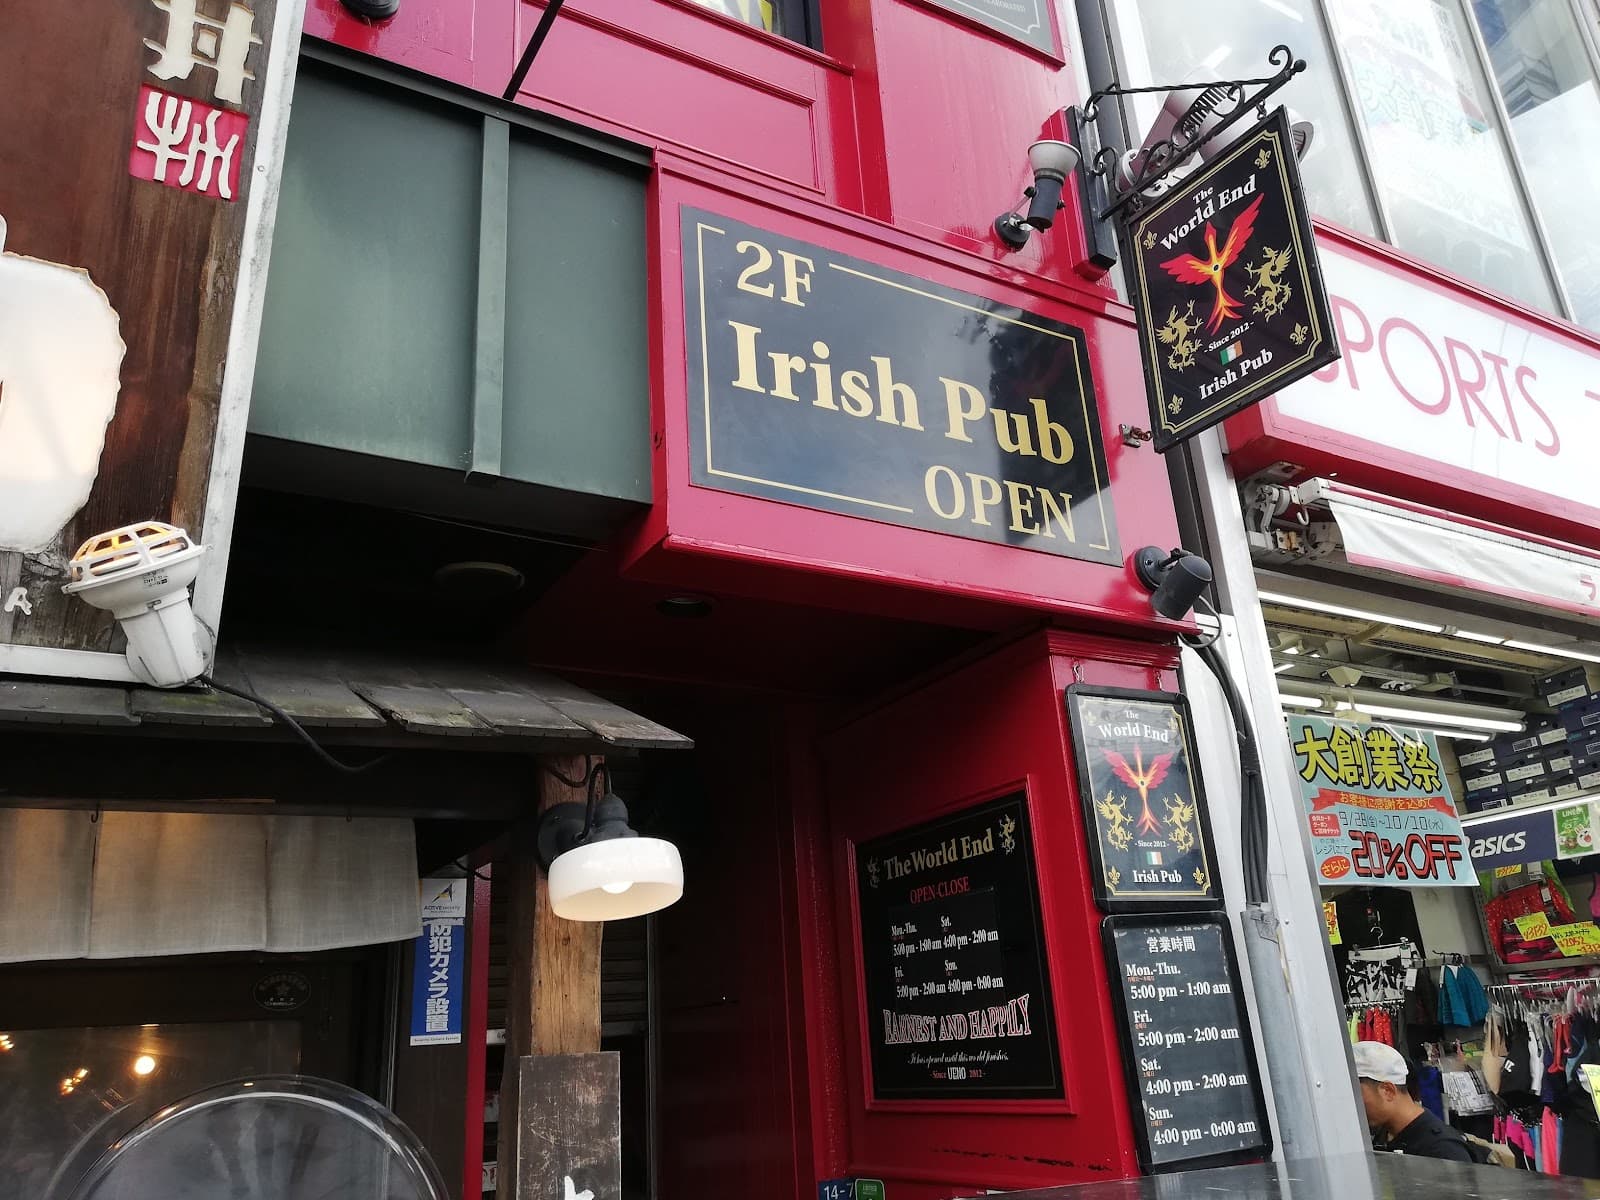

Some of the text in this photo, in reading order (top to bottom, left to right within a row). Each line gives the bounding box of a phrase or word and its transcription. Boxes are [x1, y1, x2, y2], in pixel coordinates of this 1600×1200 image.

[1193, 185, 1213, 204] The
[1160, 175, 1256, 250] World End
[736, 240, 814, 307] 2F
[1230, 324, 1250, 341] 2012
[1199, 350, 1272, 400] Irish Pub
[1312, 294, 1560, 457] PORTS
[728, 319, 1074, 464] Irish Pub
[925, 466, 1075, 543] OPEN
[1124, 710, 1139, 720] The
[1099, 722, 1169, 743] World End
[1295, 725, 1442, 794] 大創業祭
[884, 828, 994, 880] The World End
[1153, 840, 1167, 848] 2012
[1348, 830, 1462, 880] 20%OFF
[1133, 870, 1182, 883] Irish Pub
[1321, 858, 1349, 877] さらに
[910, 876, 969, 904] OPEN-CLOSE
[958, 936, 968, 949] pm
[972, 929, 986, 943] 2:00
[987, 930, 998, 940] am
[1147, 935, 1196, 953] 営業時間
[425, 918, 453, 1033] 防犯カメラ設置
[1125, 962, 1181, 977] Mon.-Thu.
[936, 983, 946, 993] am
[961, 981, 973, 995] pm
[992, 976, 1003, 988] am
[1131, 985, 1155, 1000] 5:00
[1158, 988, 1178, 1002] pm
[1187, 982, 1211, 996] 1:00
[1213, 983, 1231, 994] am
[1133, 1010, 1153, 1023] Fri.
[939, 1013, 968, 1041] AND
[1137, 1032, 1163, 1047] 5:00
[1165, 1034, 1185, 1048] pm
[1194, 1028, 1219, 1042] 2:00
[1221, 1028, 1239, 1040] am
[1141, 1058, 1161, 1072] Sat.
[1146, 1079, 1171, 1095] 4:00
[1174, 1082, 1193, 1097] pm
[1202, 1074, 1227, 1089] 2:00
[1229, 1073, 1248, 1086] am
[1149, 1107, 1174, 1121] Sun.
[1154, 1128, 1179, 1145] 4:00
[1182, 1129, 1202, 1145] pm
[1211, 1122, 1236, 1137] 0:00
[1237, 1121, 1256, 1133] am
